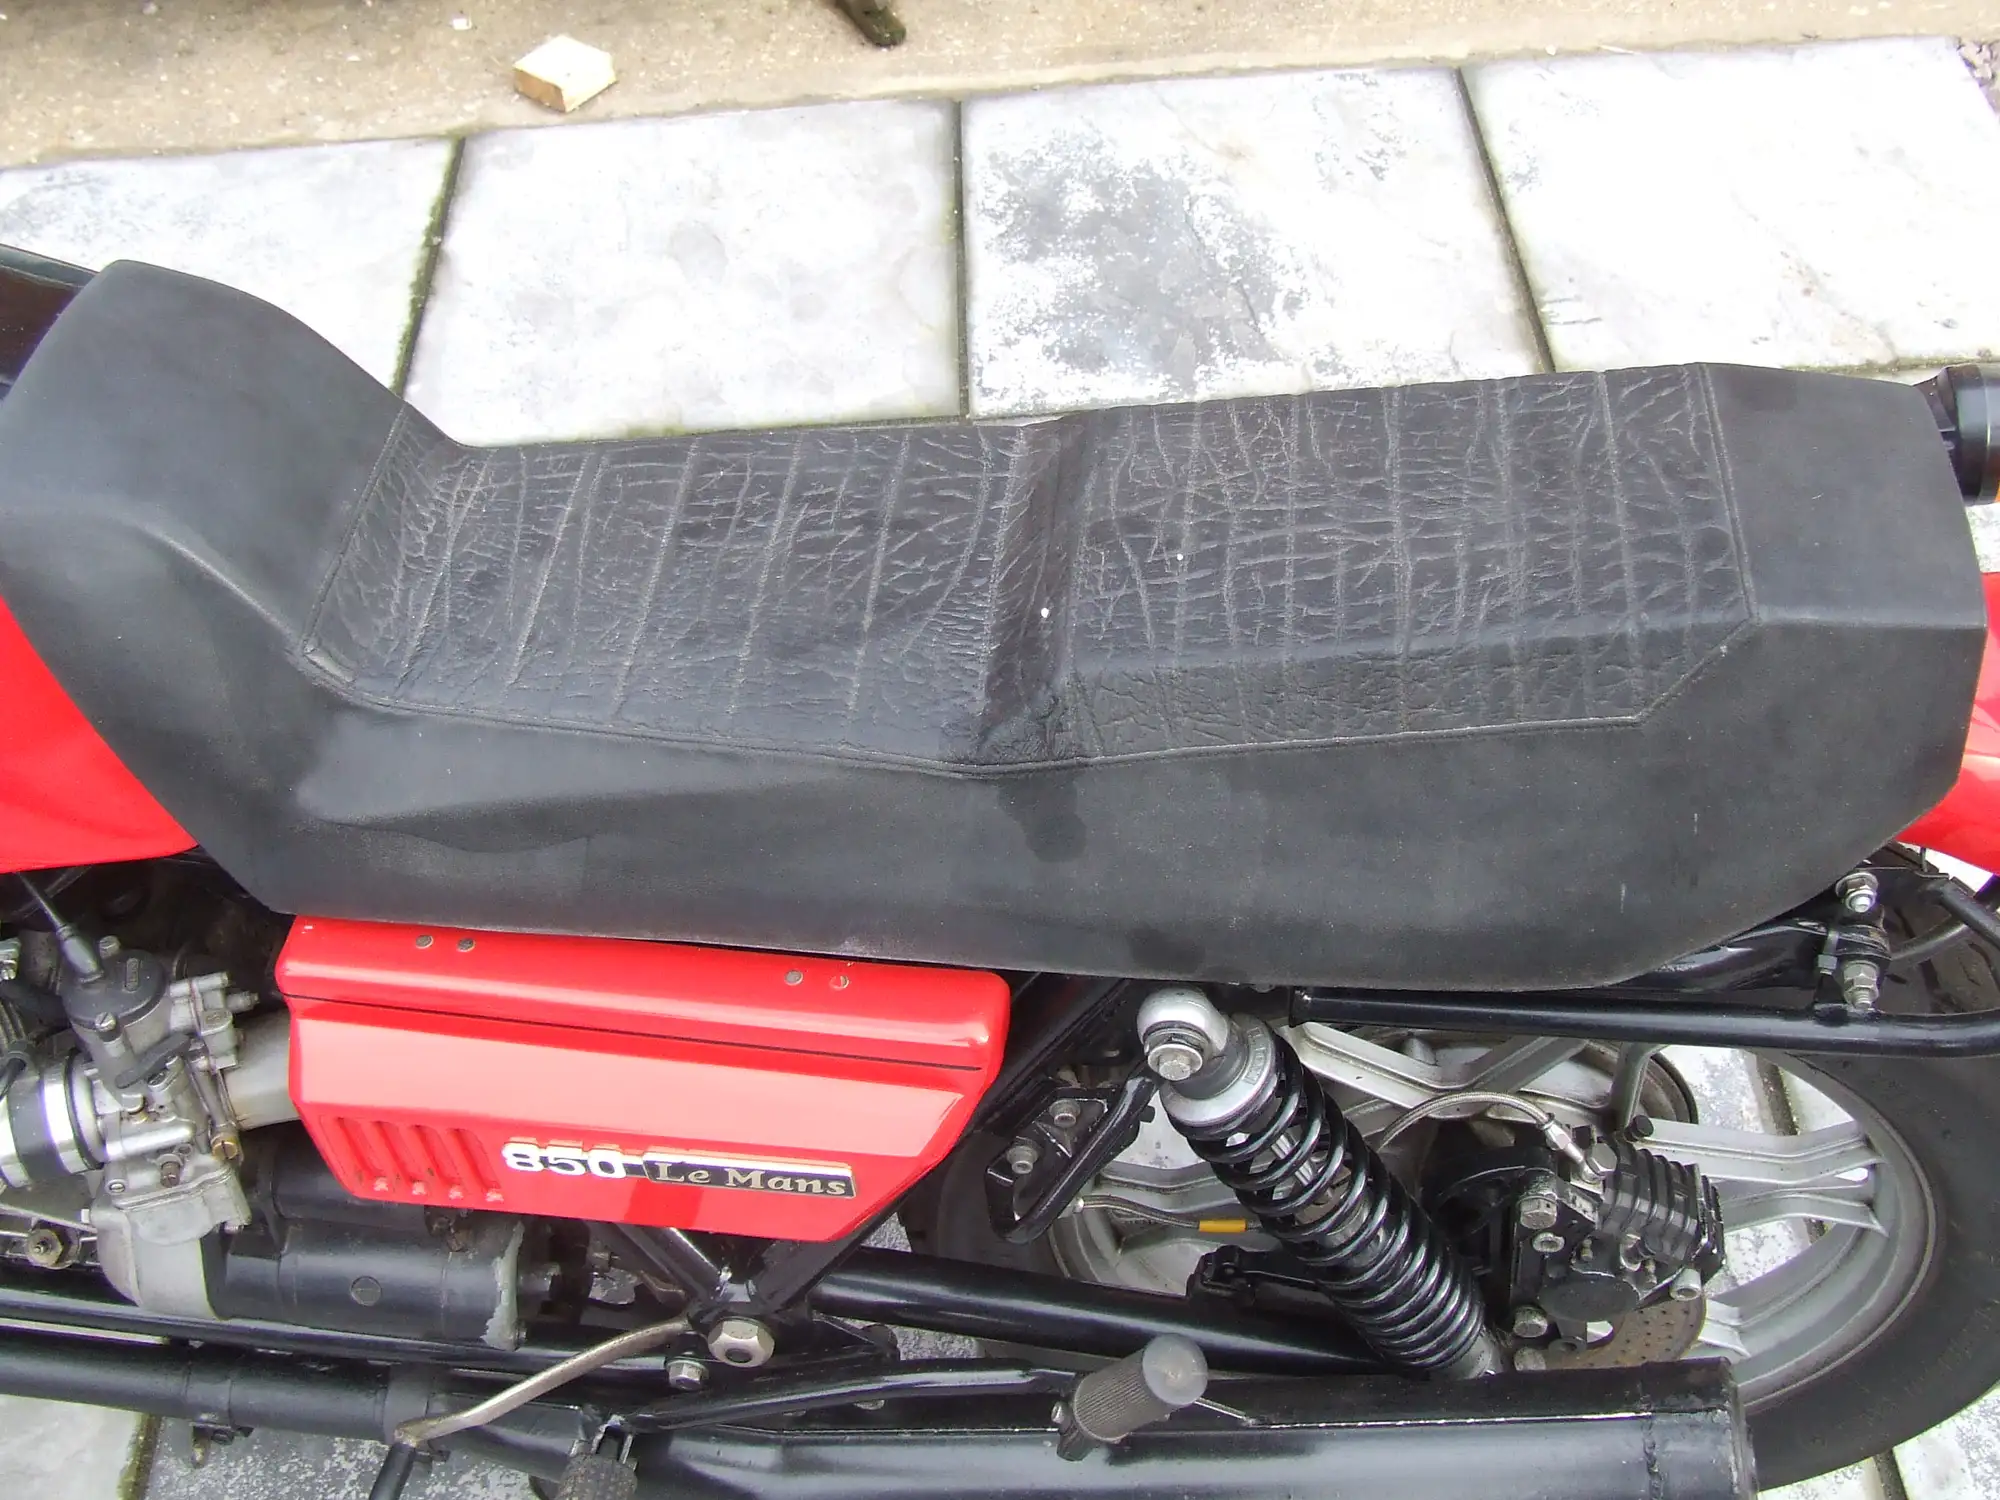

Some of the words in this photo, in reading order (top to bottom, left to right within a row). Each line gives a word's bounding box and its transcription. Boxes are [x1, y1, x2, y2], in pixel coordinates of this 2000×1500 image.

[502, 1141, 627, 1178] 850
[654, 1162, 711, 1183] Le
[724, 1168, 846, 1195] Mans
